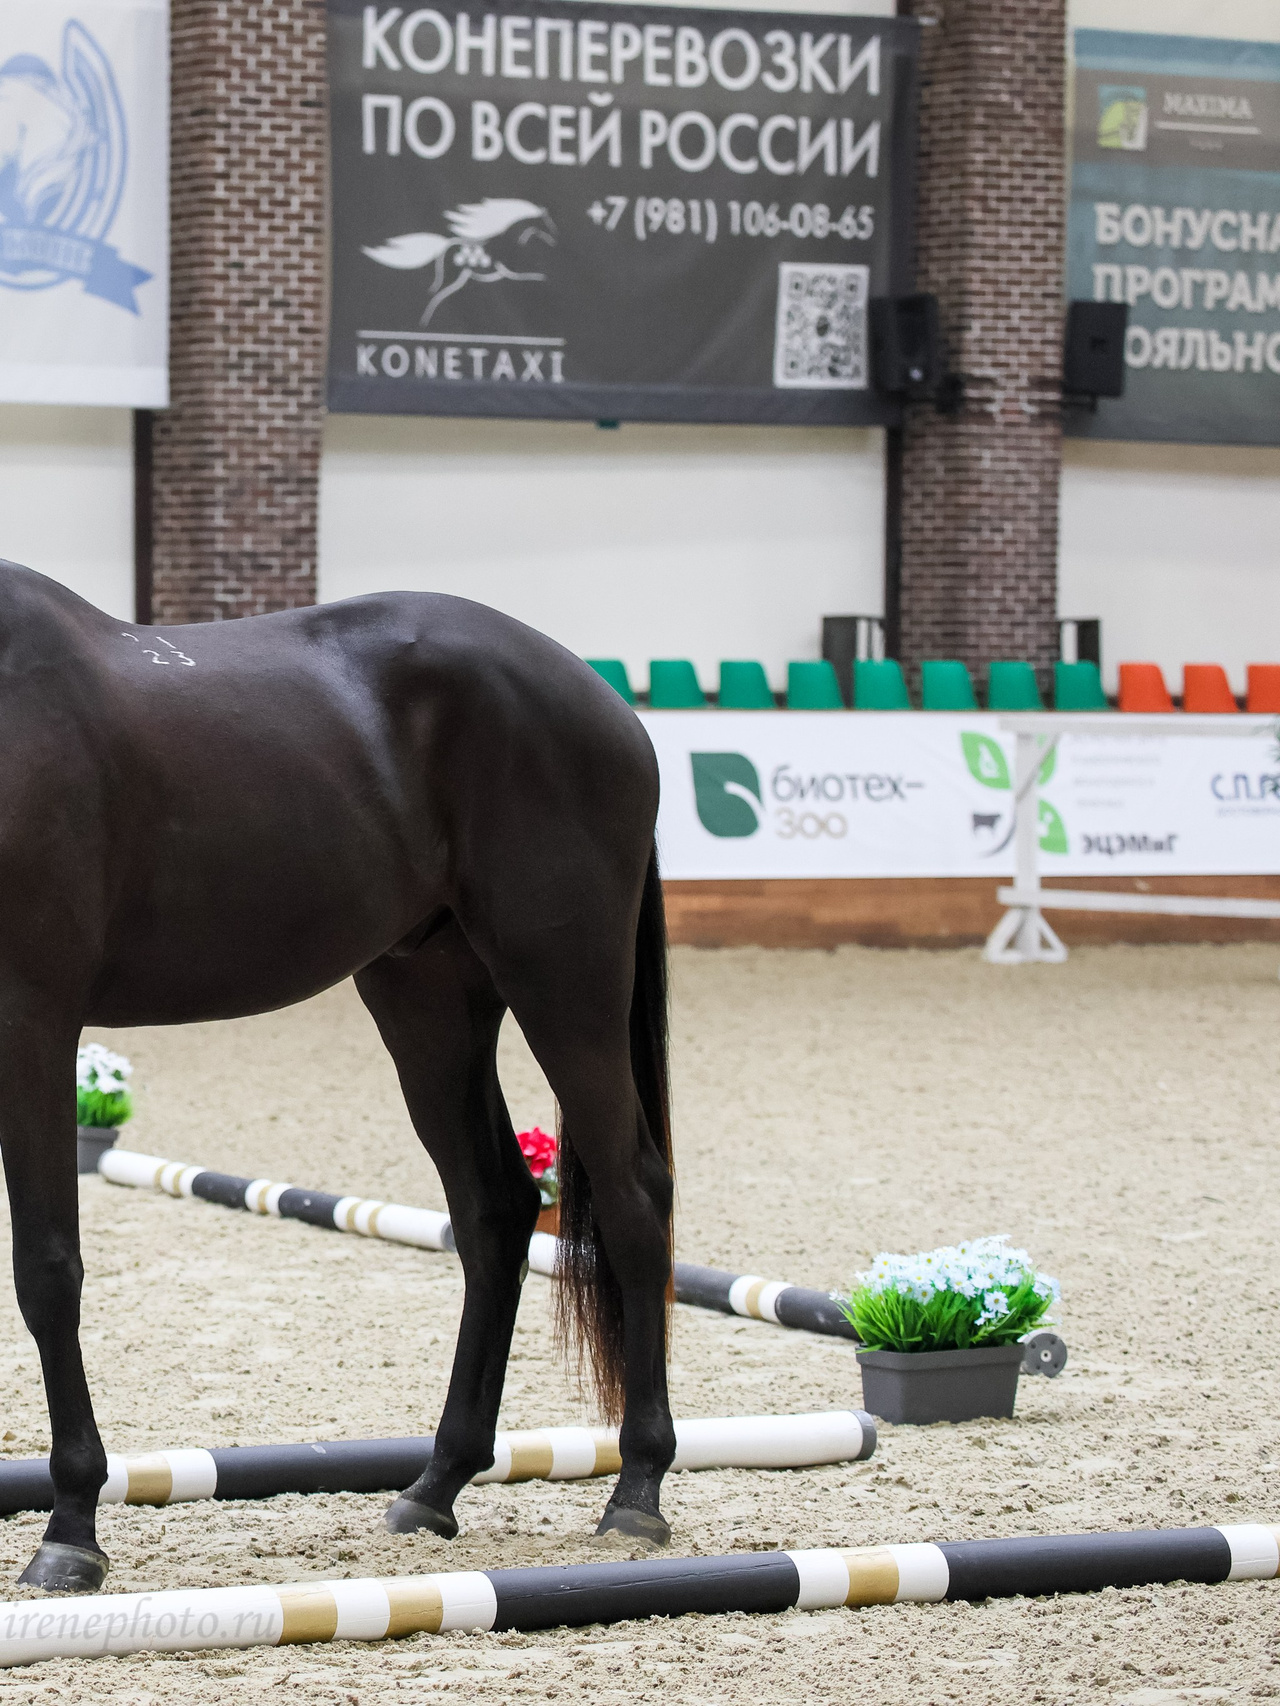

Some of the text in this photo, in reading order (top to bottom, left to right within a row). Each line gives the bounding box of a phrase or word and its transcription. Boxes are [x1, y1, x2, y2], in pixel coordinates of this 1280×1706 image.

[361, 6, 882, 96] КОНЕПЕРЕВОЗКИ
[361, 91, 882, 178] ПО ВСЕЙ РОССИИ
[586, 195, 875, 243] +7 (981) 106-08-65
[356, 344, 566, 384] KONETAXI
